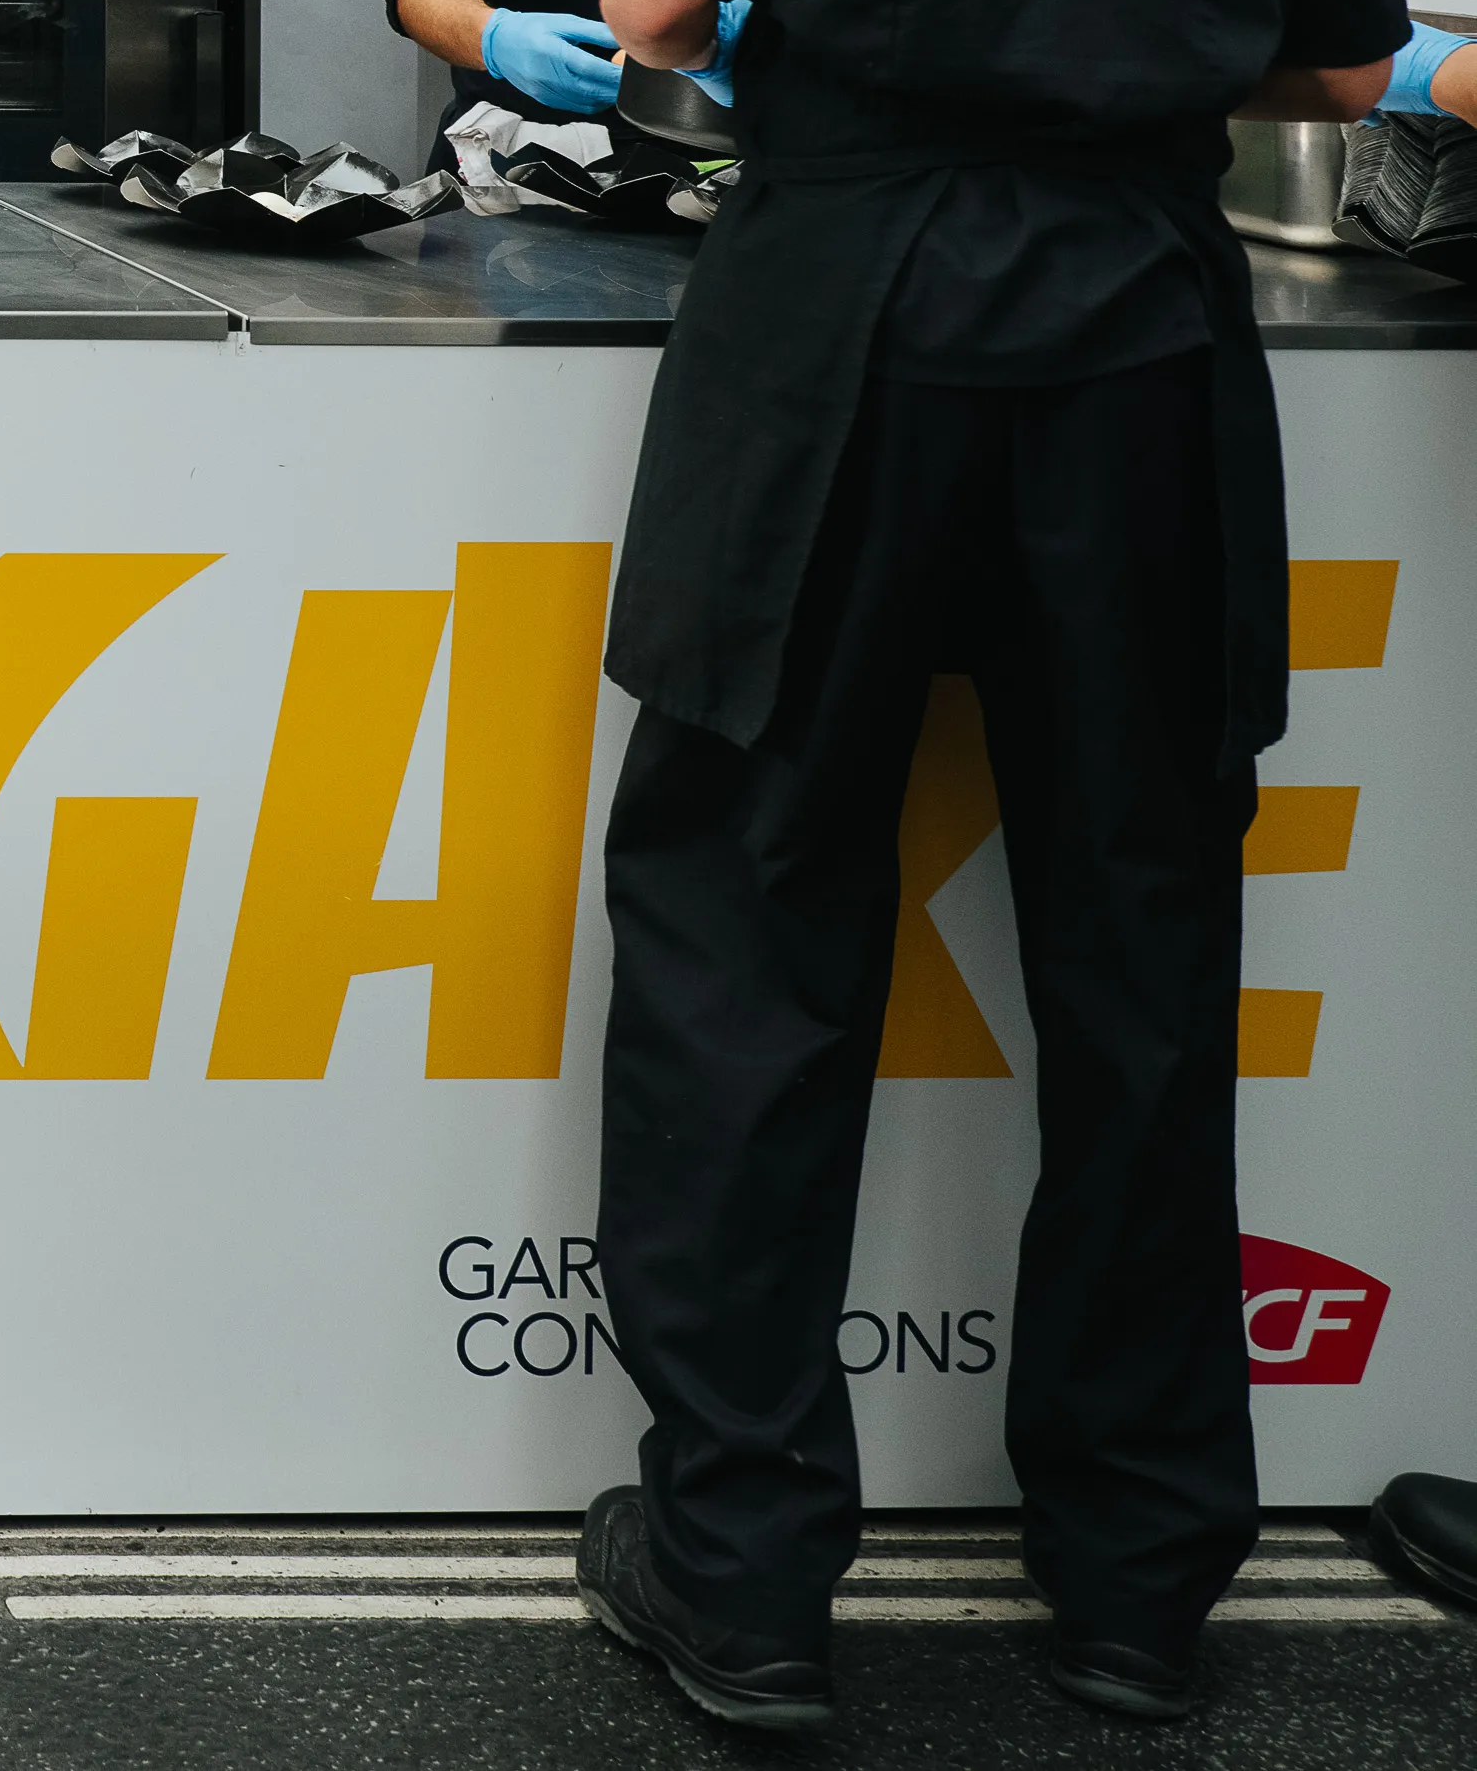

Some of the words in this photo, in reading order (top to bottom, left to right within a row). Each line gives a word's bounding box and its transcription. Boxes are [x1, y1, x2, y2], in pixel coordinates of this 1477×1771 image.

[438, 1235, 602, 1302] GAR
[456, 1309, 997, 1377] CONONS
[1242, 1288, 1368, 1364] CF
